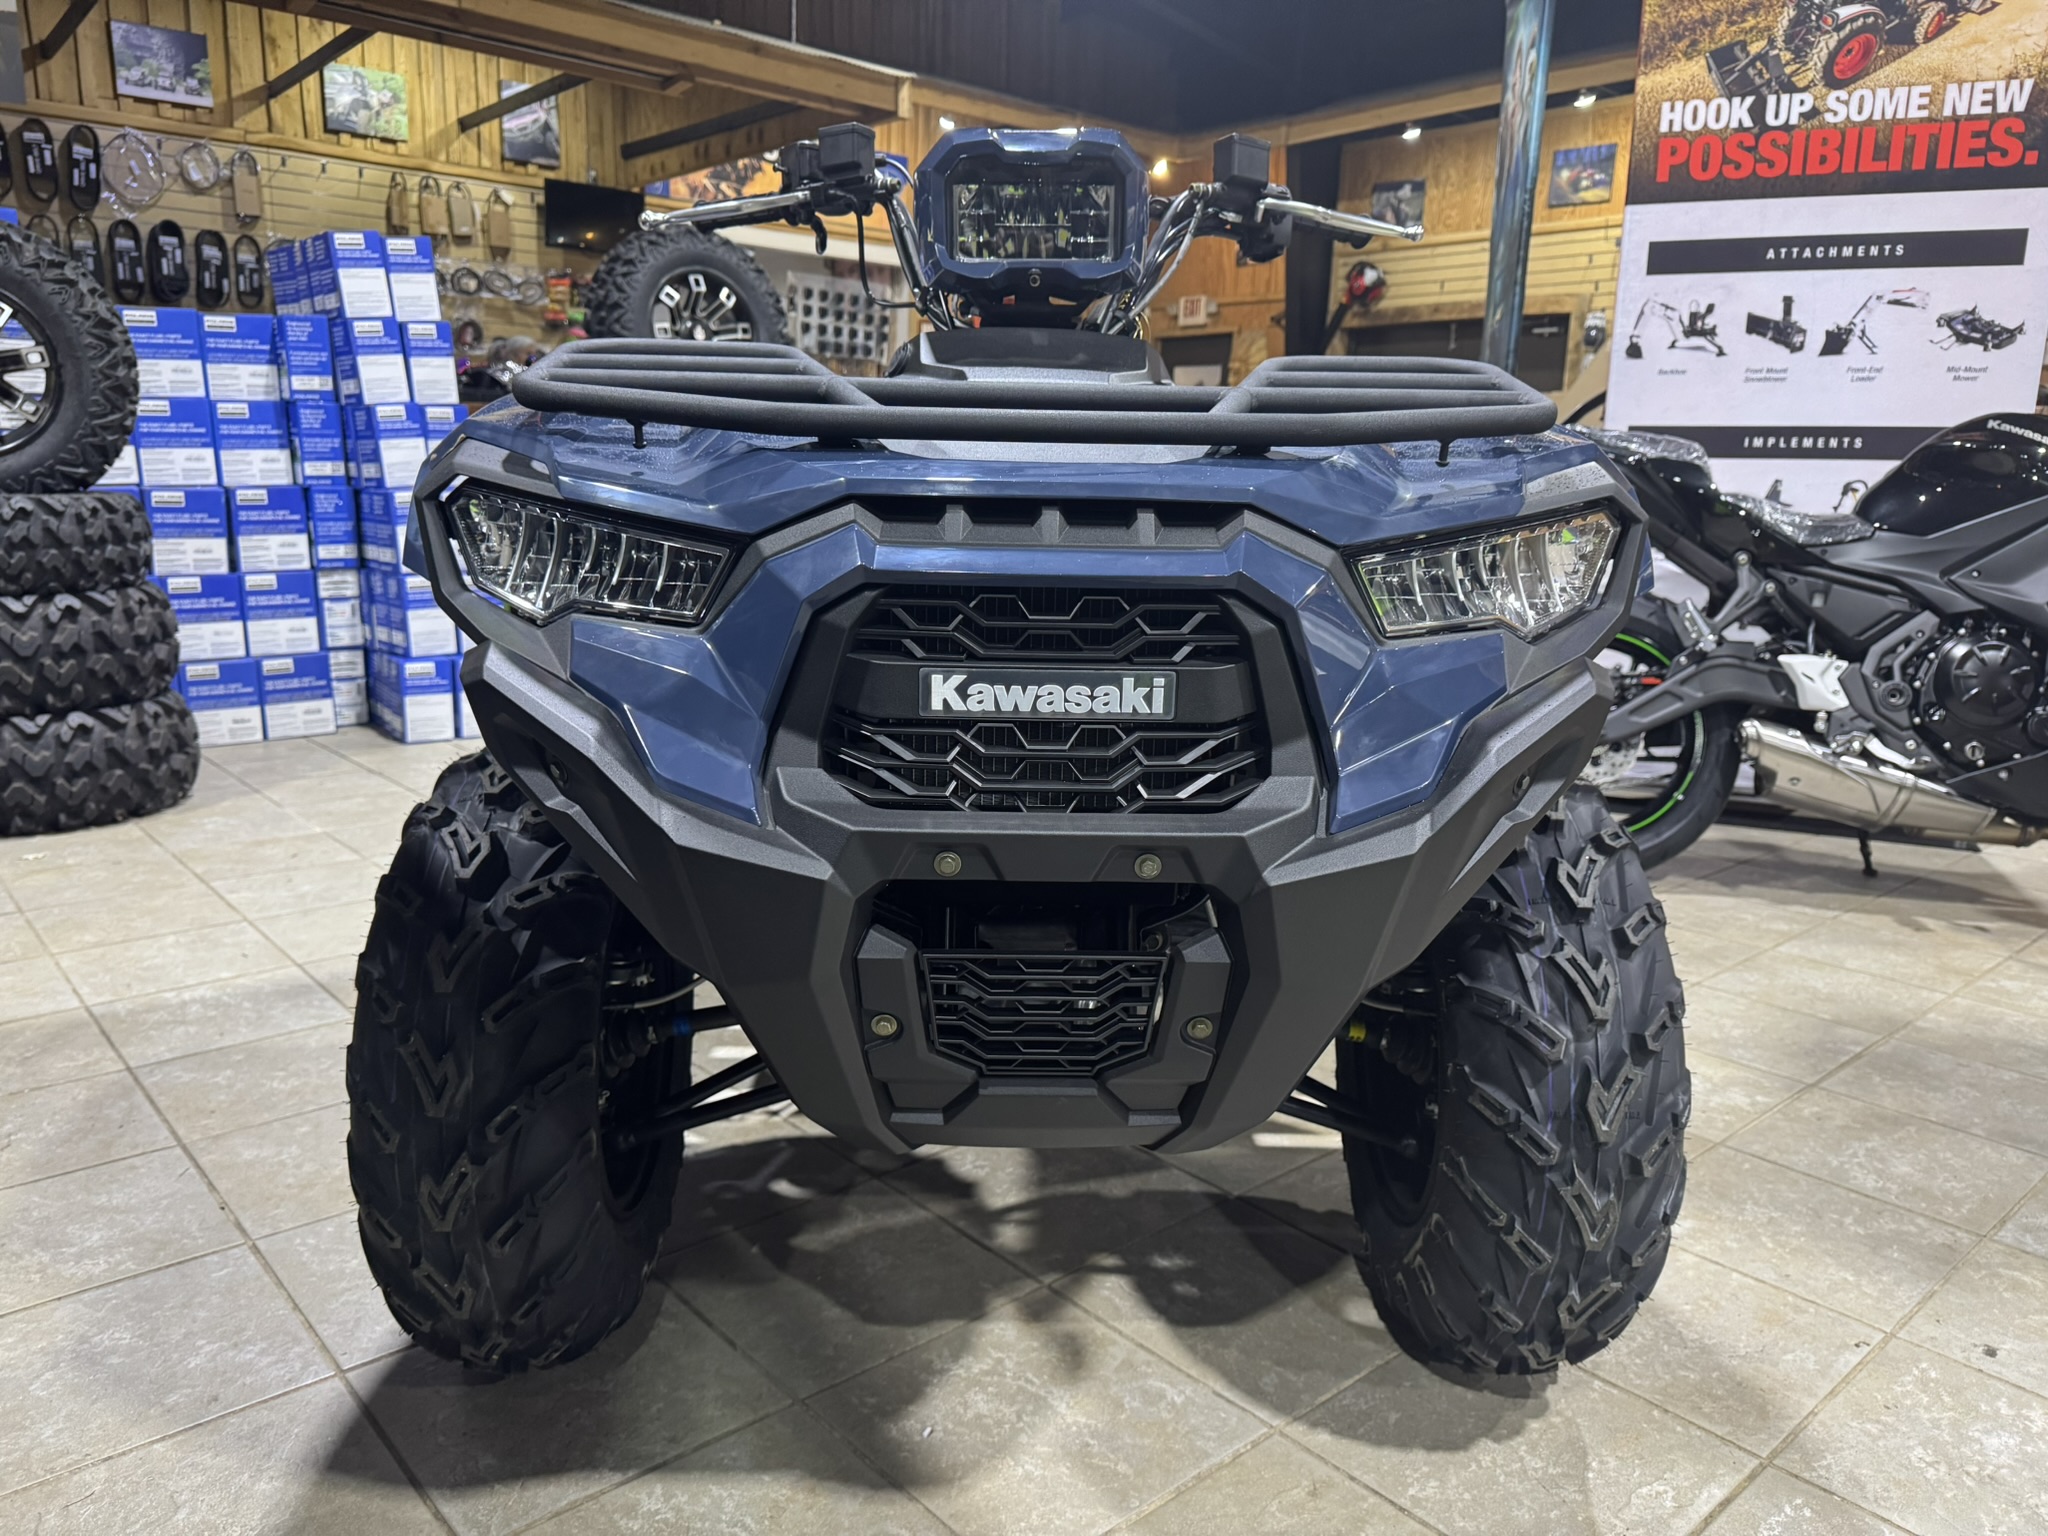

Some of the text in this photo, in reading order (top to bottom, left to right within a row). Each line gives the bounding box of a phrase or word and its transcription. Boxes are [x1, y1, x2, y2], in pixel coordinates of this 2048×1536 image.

[1659, 78, 2035, 132] HOOK UP SOME NEW
[1655, 117, 2039, 183] POSSIBILITIES.
[1765, 243, 1905, 260] ATTACHMENTS
[1743, 435, 1864, 449] IMPLEMENTS
[931, 674, 1165, 713] Kawasaki
